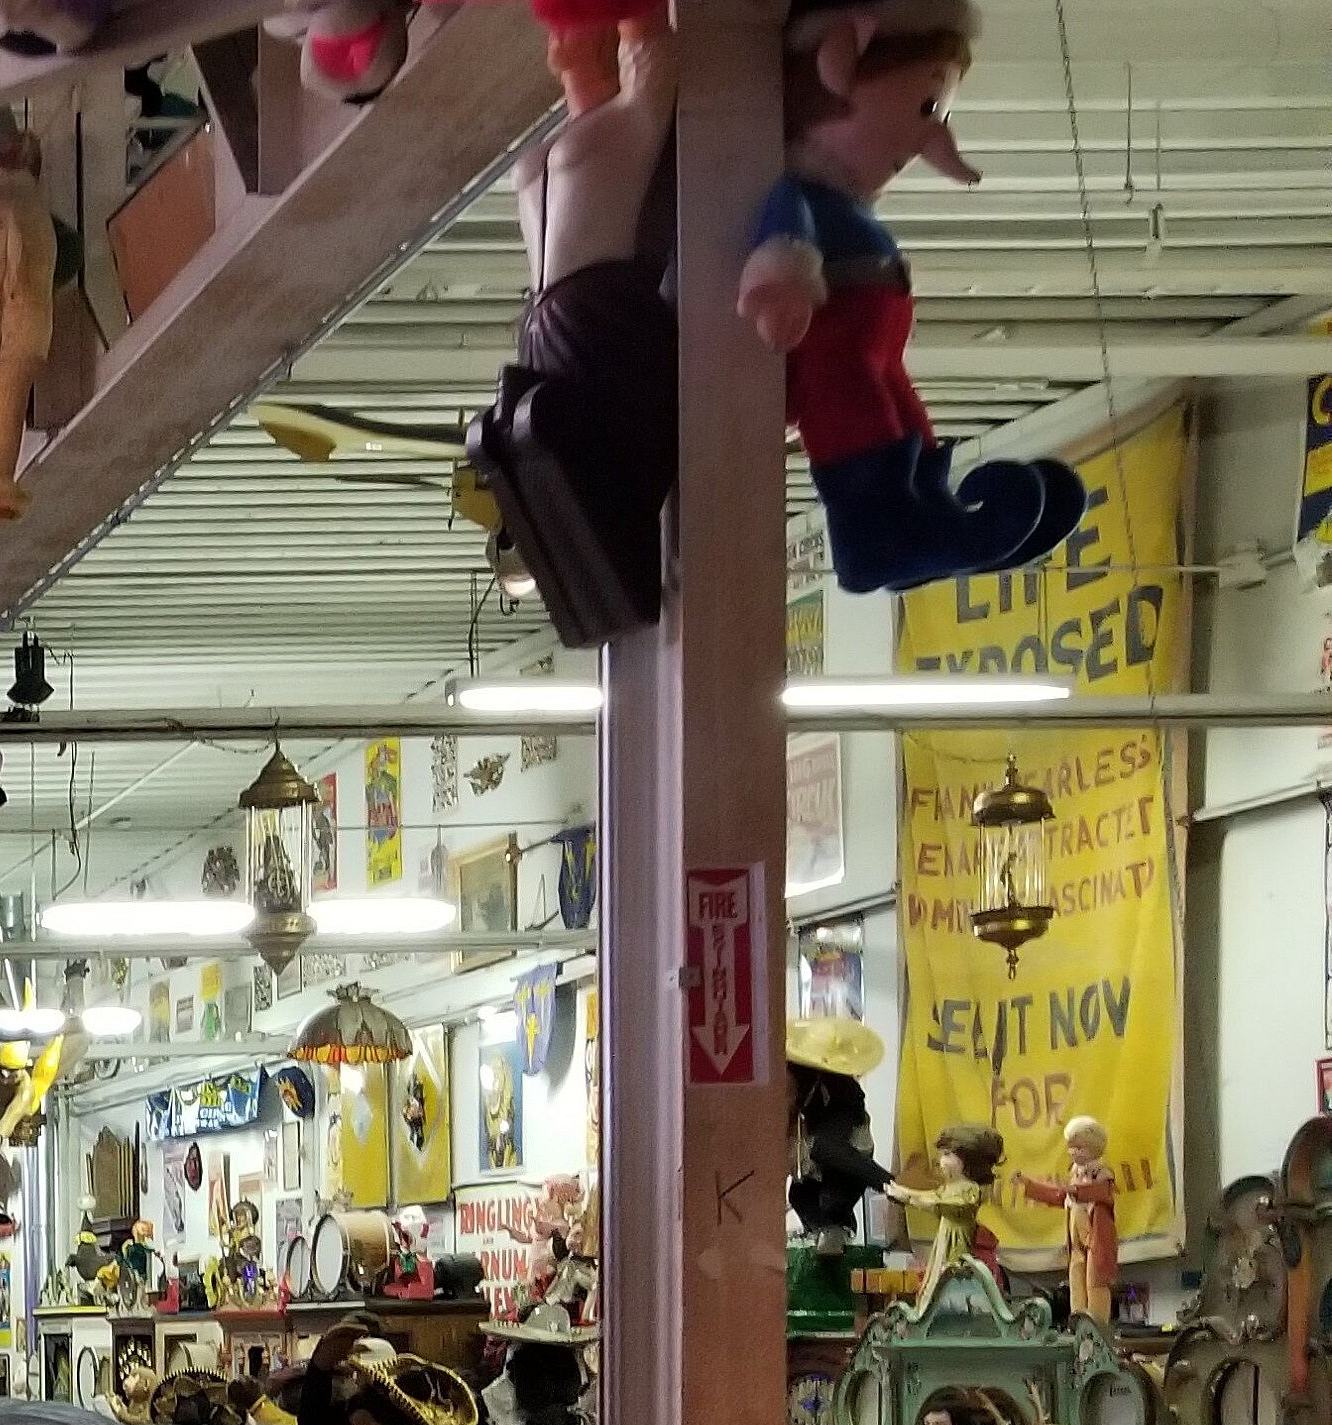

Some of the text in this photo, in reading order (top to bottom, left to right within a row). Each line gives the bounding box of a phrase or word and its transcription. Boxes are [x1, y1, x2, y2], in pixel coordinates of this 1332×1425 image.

[916, 585, 1165, 683] OSED
[699, 892, 737, 918] FIRE
[1048, 856, 1156, 918] ASCINAT
[991, 1072, 1073, 1129] FOR
[714, 1169, 755, 1227] K
[480, 1249, 529, 1281] RNUM
